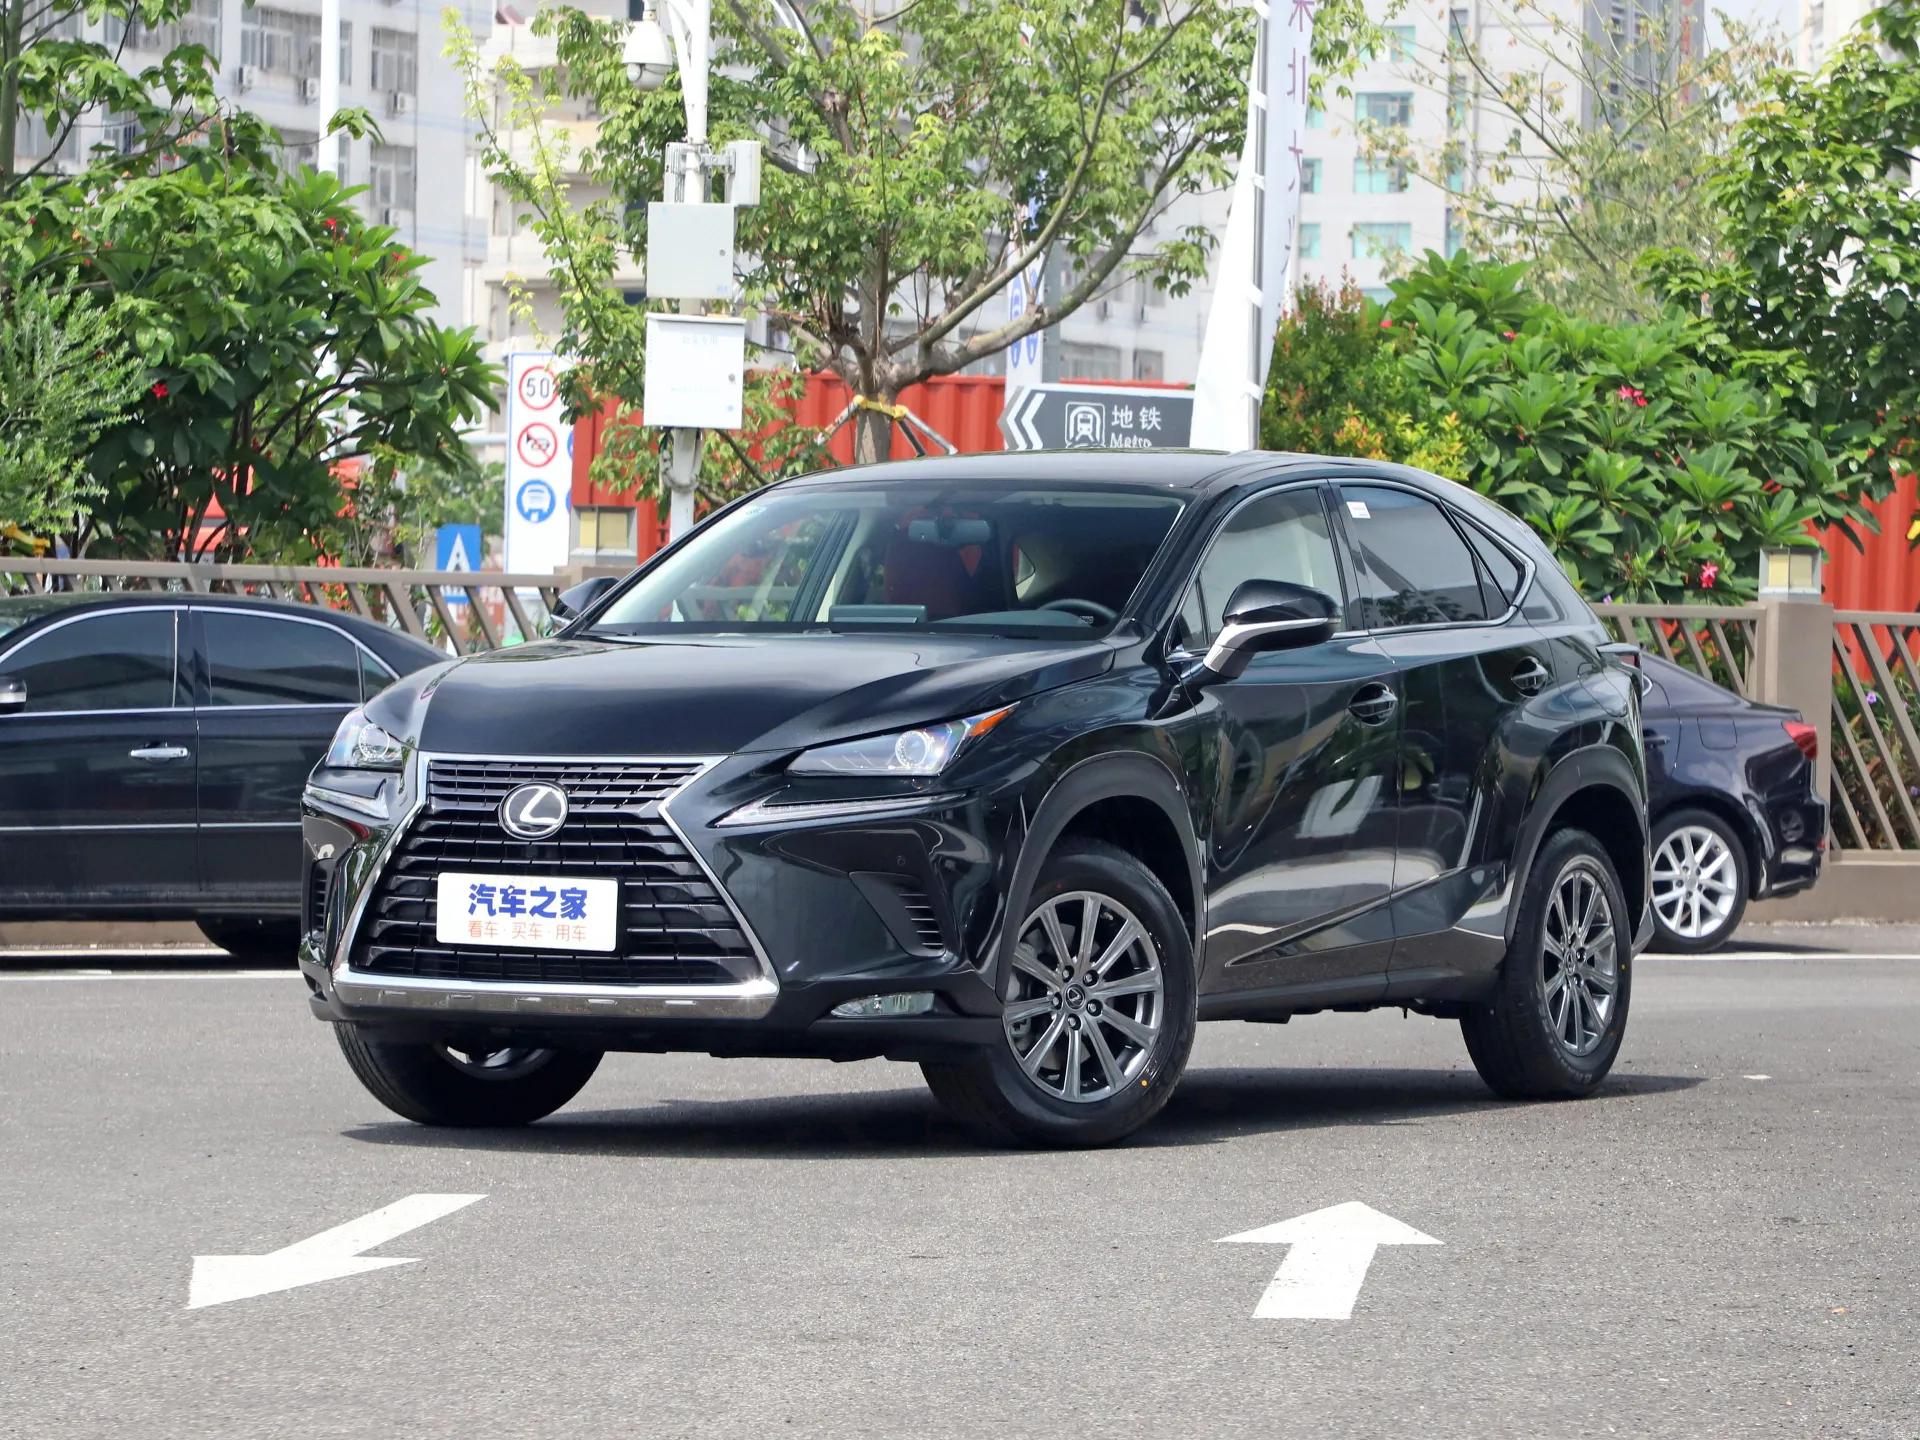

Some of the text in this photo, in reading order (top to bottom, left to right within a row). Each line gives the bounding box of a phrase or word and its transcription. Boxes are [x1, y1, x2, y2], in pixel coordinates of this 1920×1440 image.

[527, 377, 551, 398] 50
[1111, 404, 1162, 431] 地铁
[468, 883, 588, 921] 汽车之家
